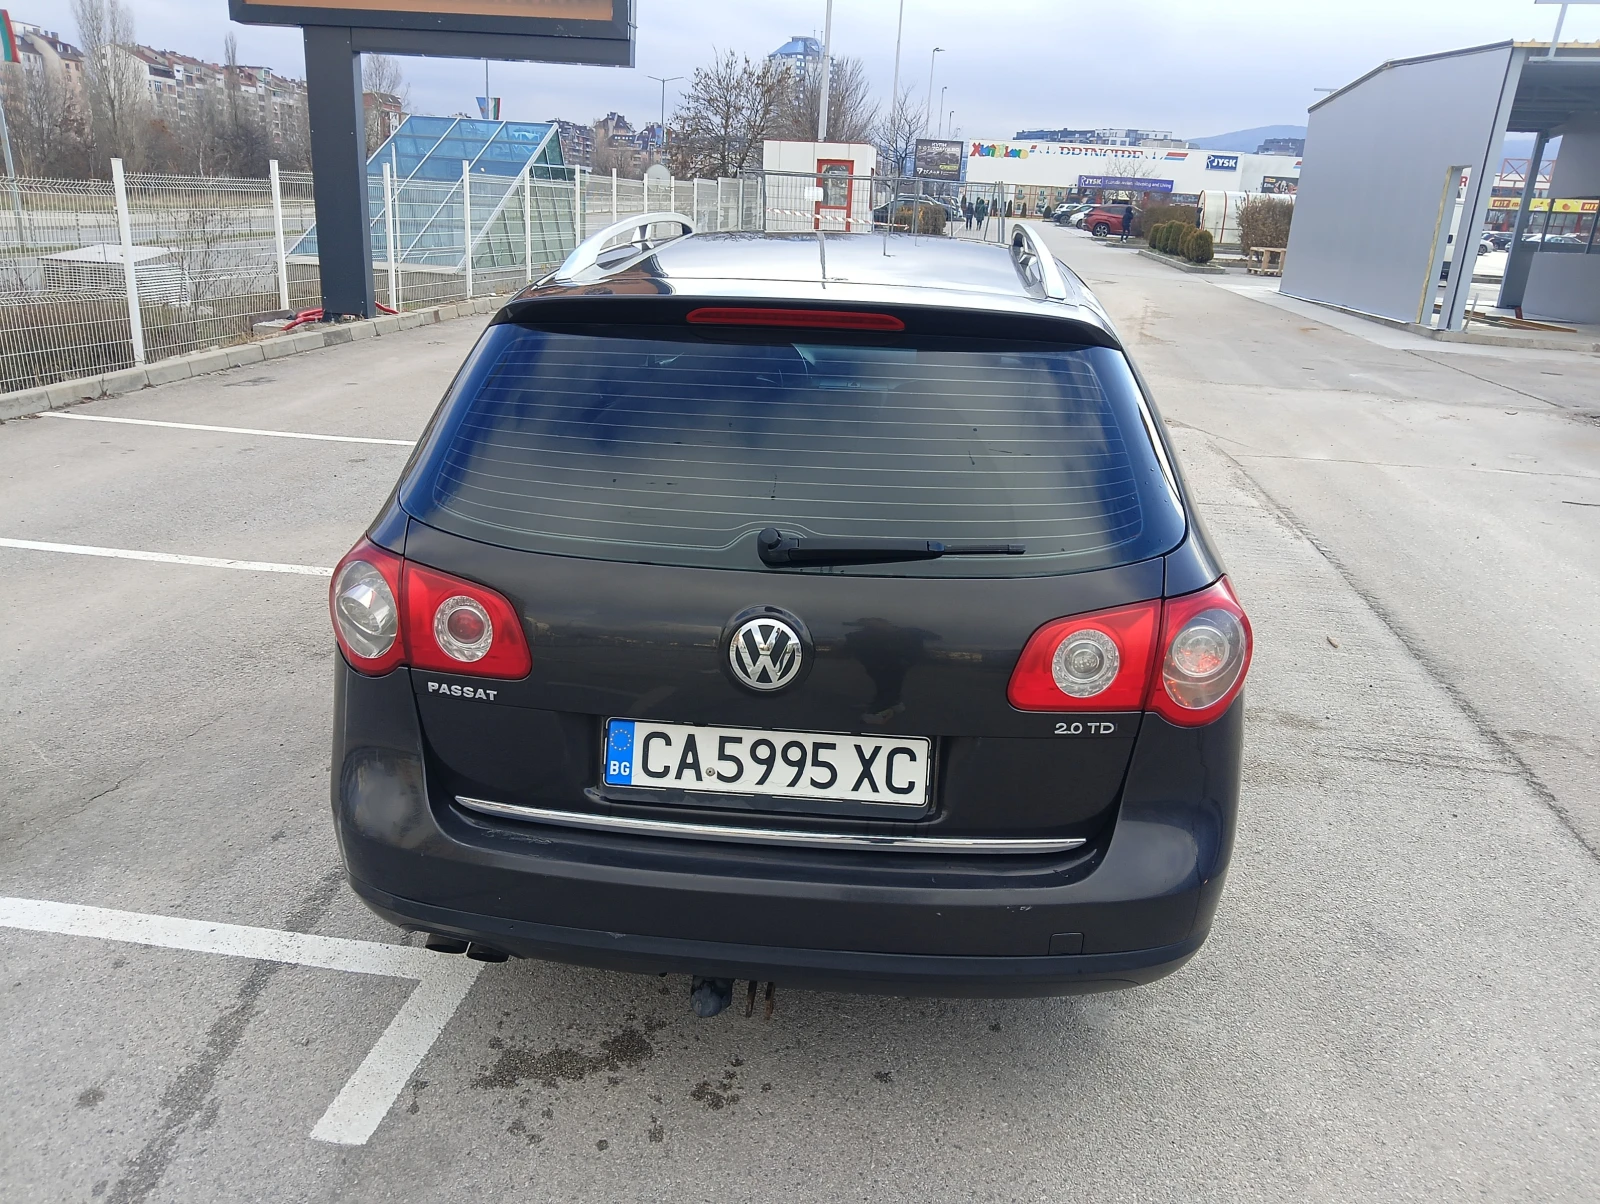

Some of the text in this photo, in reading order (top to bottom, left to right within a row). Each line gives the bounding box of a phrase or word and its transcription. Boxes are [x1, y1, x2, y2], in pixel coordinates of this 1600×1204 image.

[1212, 158, 1236, 168] JYSK
[427, 681, 498, 701] PASSAT
[609, 760, 630, 776] BG
